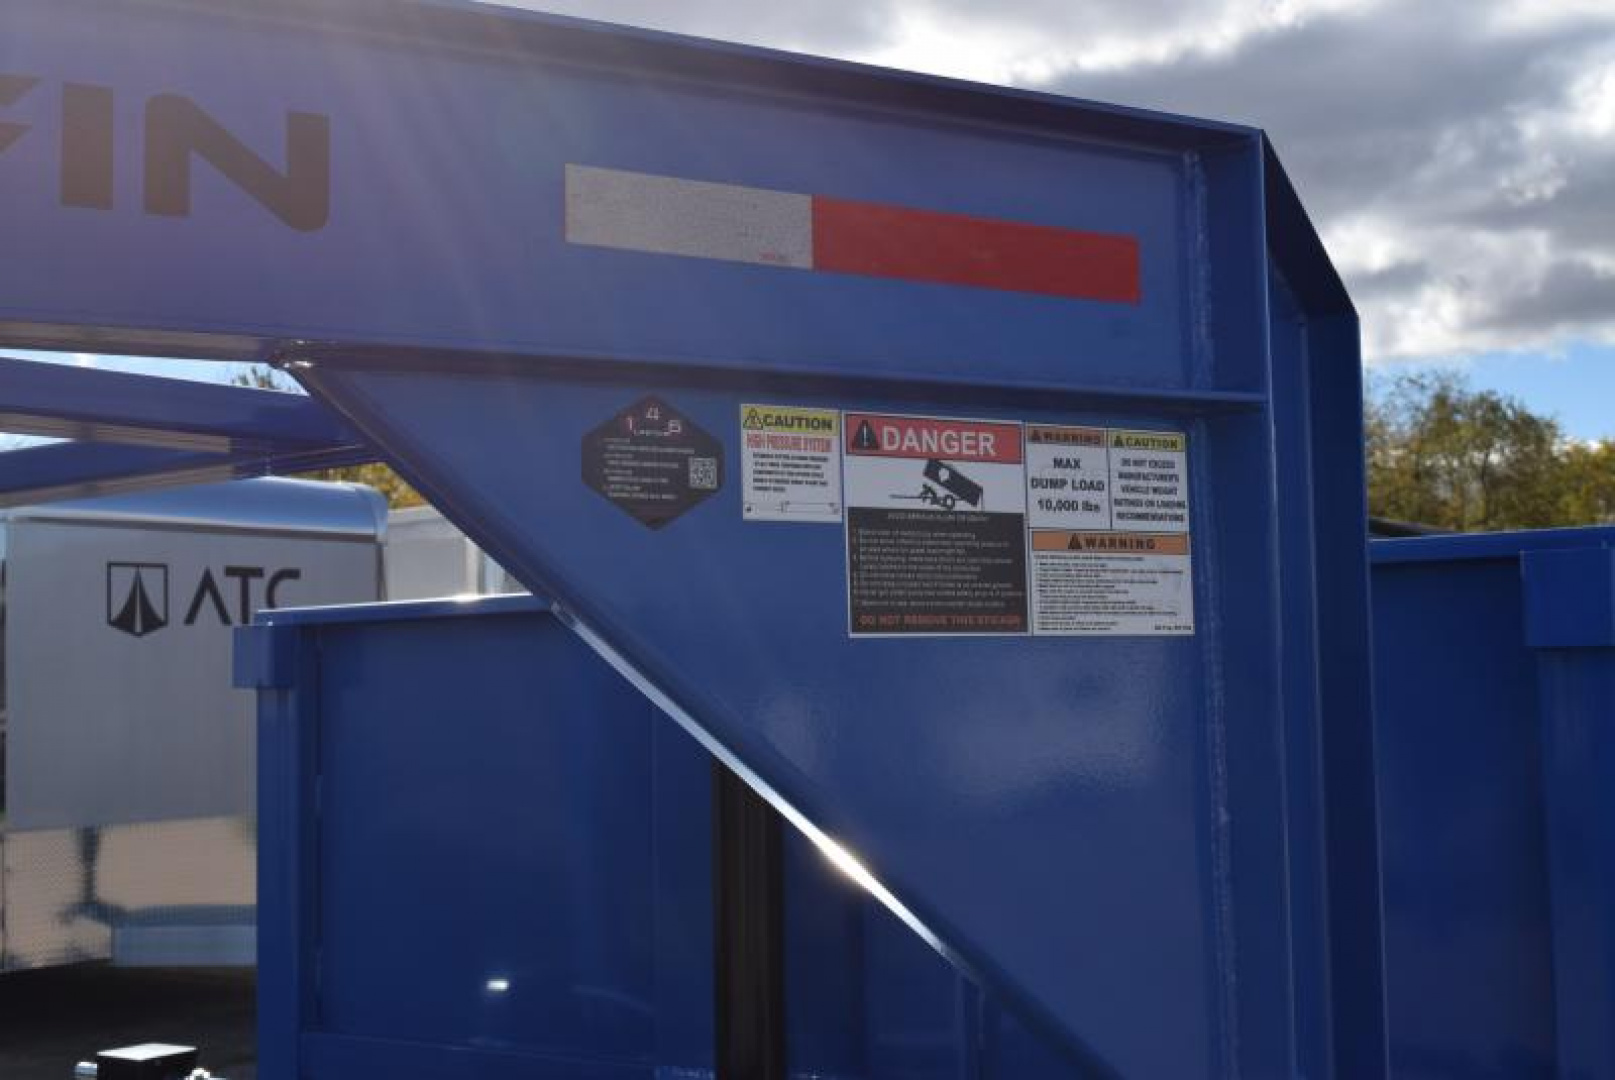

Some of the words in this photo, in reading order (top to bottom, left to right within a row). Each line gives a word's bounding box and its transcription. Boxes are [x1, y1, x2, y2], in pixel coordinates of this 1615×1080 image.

[763, 413, 833, 430] CAUTION
[882, 425, 996, 456] DANGER
[1043, 431, 1101, 445] WARNING
[1126, 437, 1178, 449] CAUTION
[1053, 457, 1081, 469] MAX
[1031, 477, 1068, 490] DUMP
[1071, 479, 1105, 491] LOAD
[1037, 499, 1079, 513] 10,000
[1085, 538, 1155, 550] WARNING
